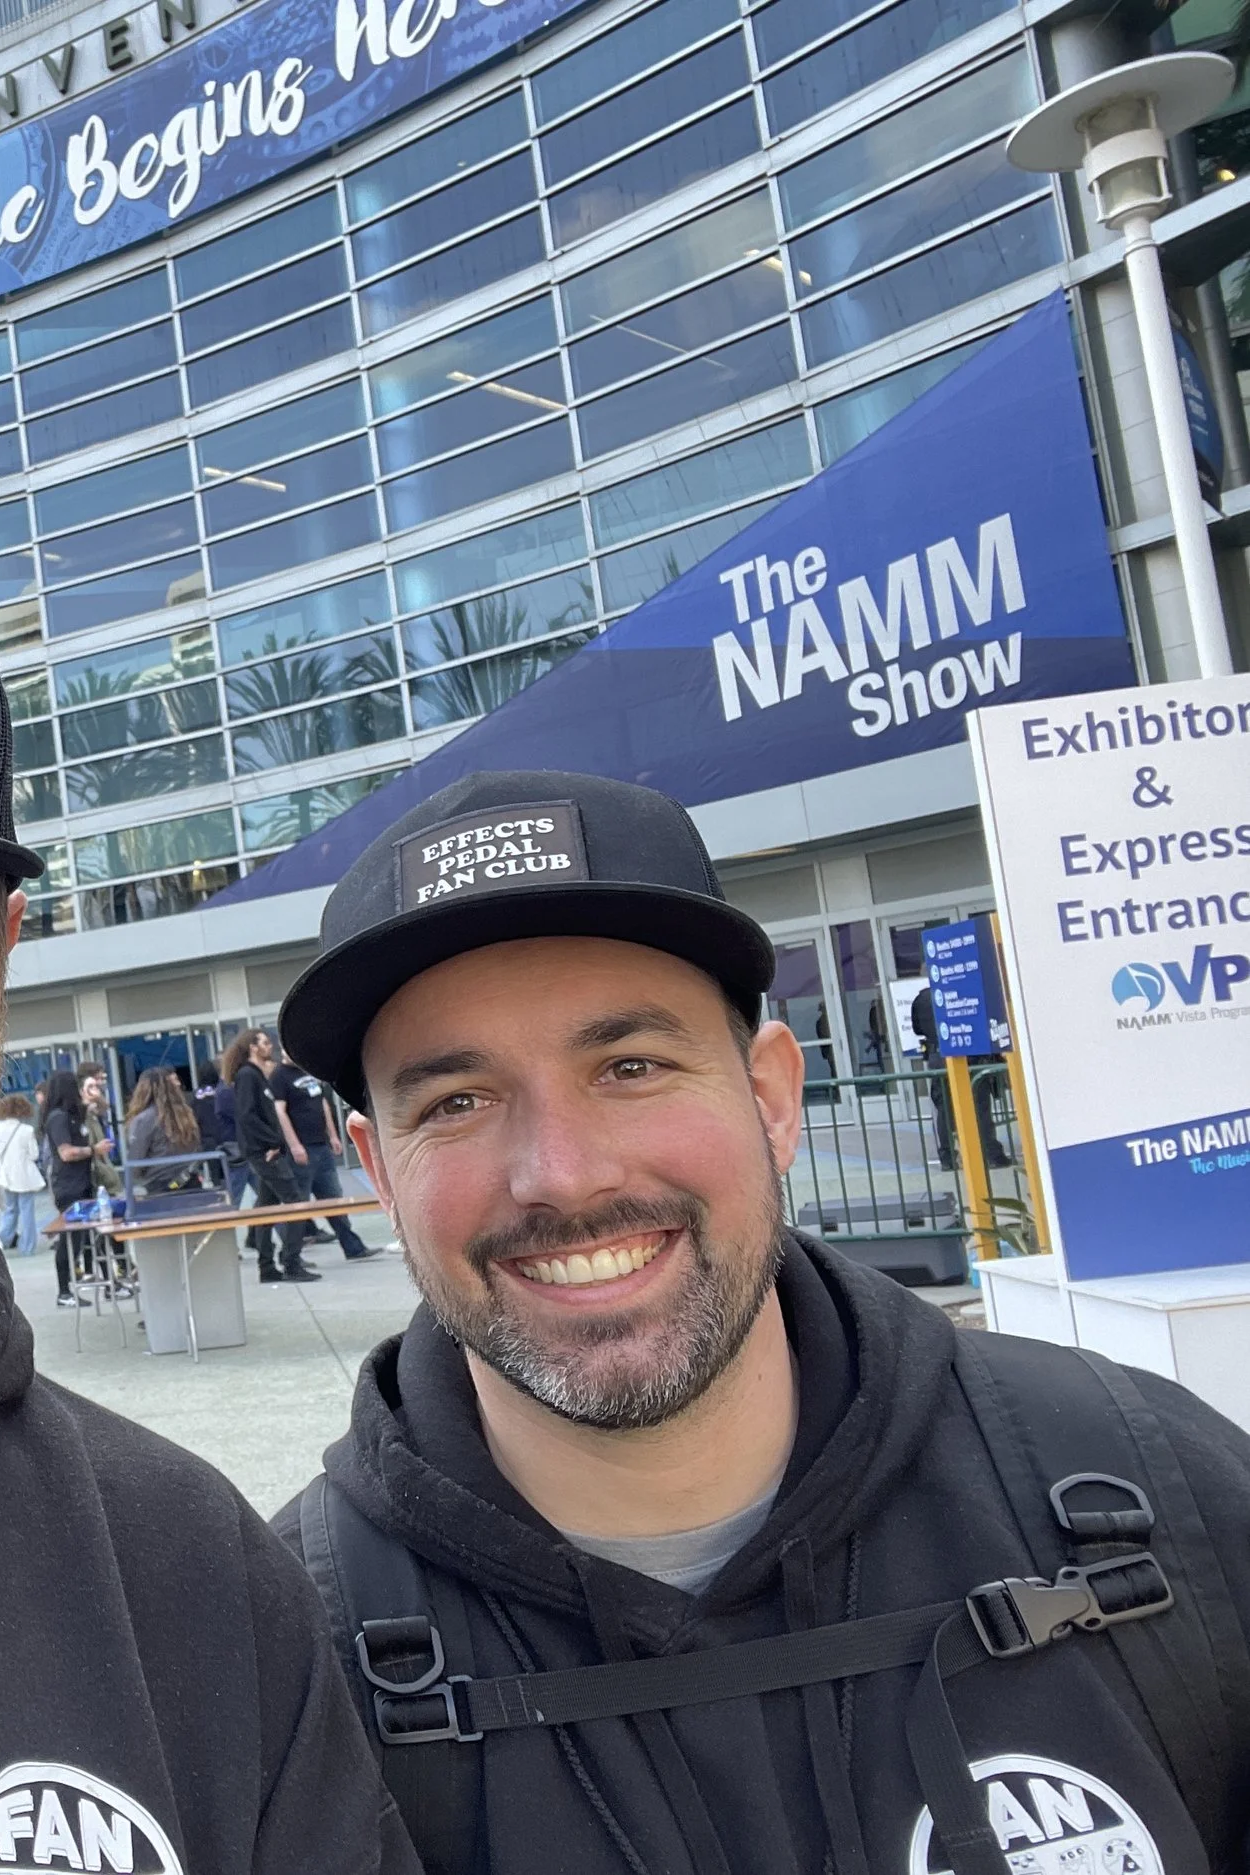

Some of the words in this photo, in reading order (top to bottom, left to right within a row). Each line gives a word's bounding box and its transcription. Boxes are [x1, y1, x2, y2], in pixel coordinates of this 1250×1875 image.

[66, 55, 314, 226] Begins
[334, 0, 507, 82] He
[719, 546, 828, 624] The
[713, 513, 1026, 722] NAMM
[849, 631, 1022, 738] Show
[1022, 700, 1250, 760] Exhibitor
[1132, 766, 1174, 808] &
[421, 817, 555, 863] EFFECTS
[438, 839, 542, 876] PEDAL
[1060, 824, 1250, 880] Express
[417, 868, 476, 904] FAN
[484, 853, 571, 879] CLUB
[1116, 1012, 1172, 1030] NAMM
[1176, 1009, 1207, 1022] Vista
[1126, 1138, 1178, 1166] The
[988, 1778, 1094, 1850] AN
